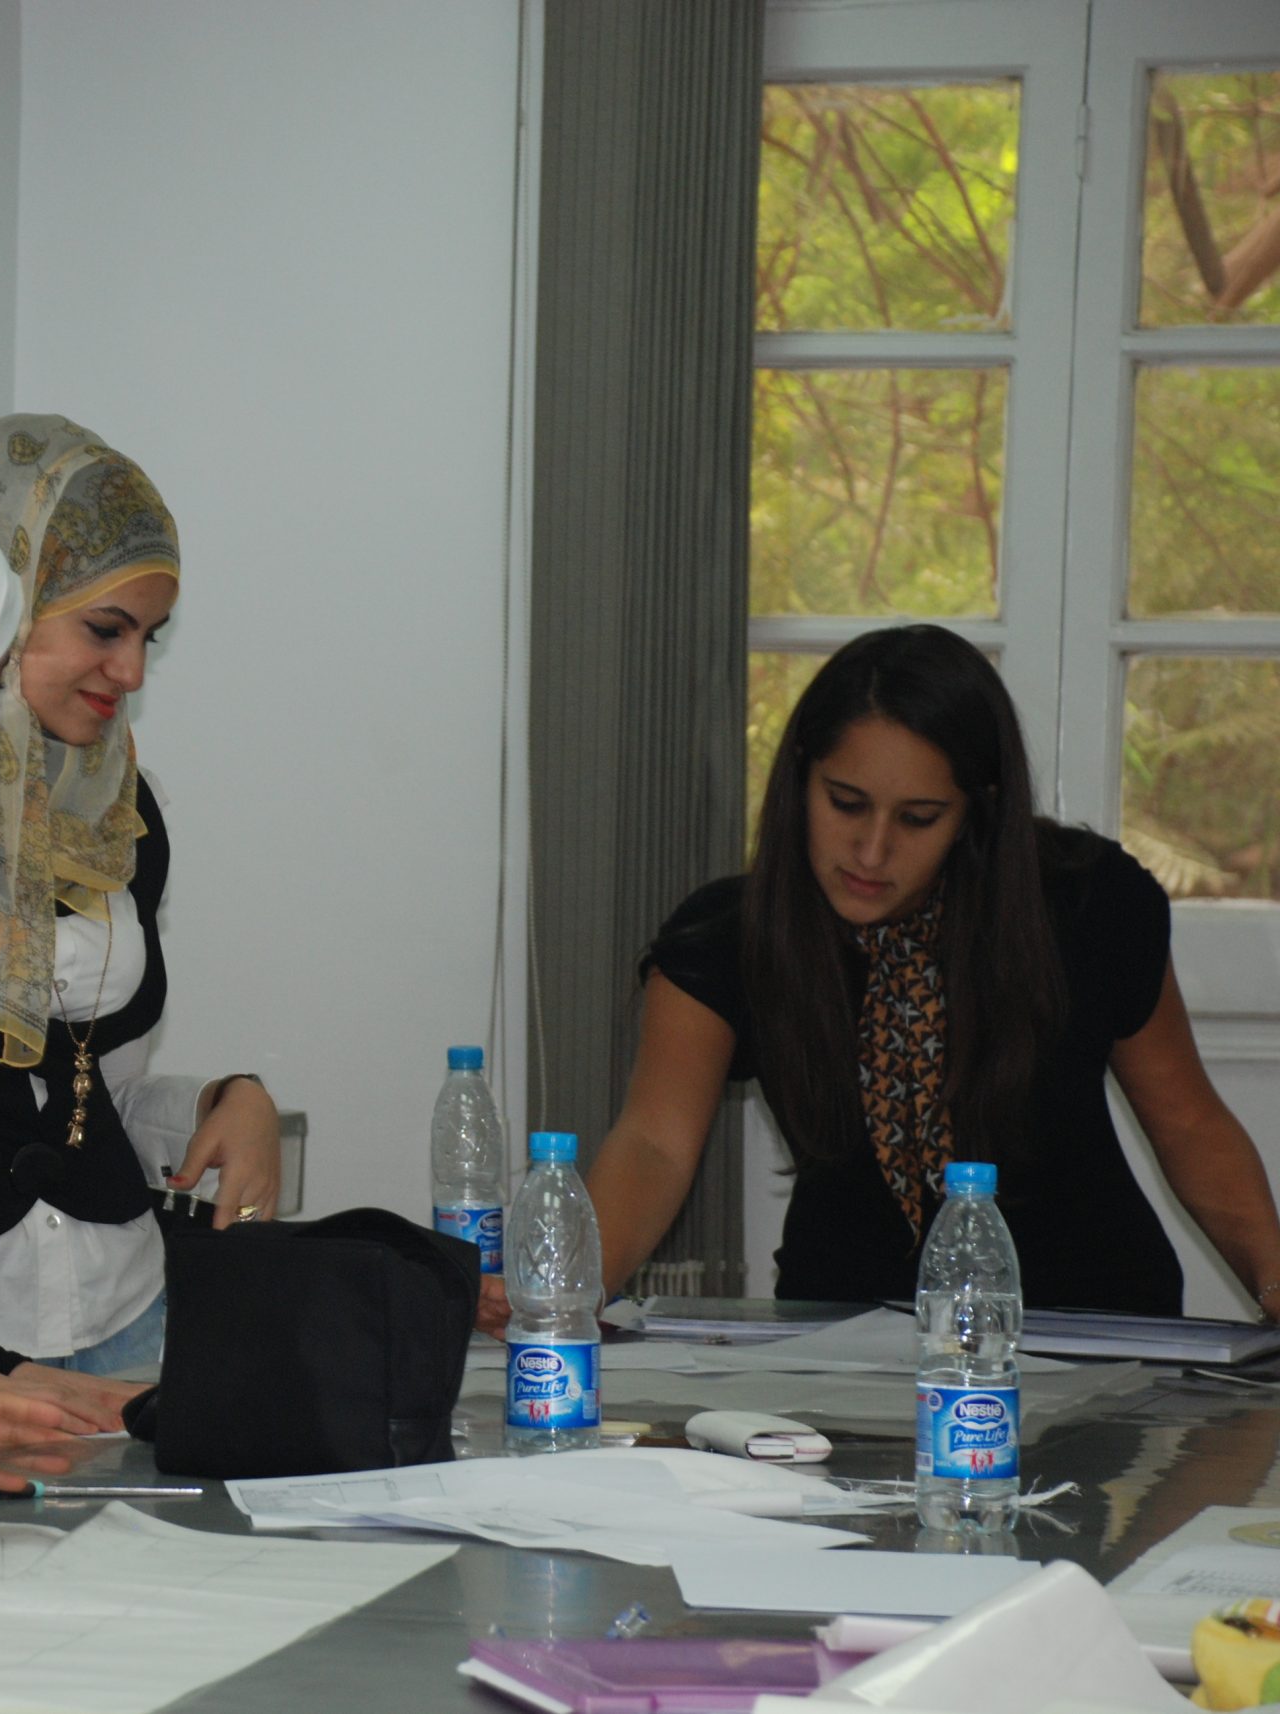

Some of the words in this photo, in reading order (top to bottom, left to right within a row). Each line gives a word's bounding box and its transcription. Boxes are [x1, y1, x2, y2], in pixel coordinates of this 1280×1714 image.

[517, 1381, 539, 1393] Pure
[540, 1380, 565, 1393] Life
[953, 1429, 983, 1443] Pure
[985, 1428, 1006, 1442] Life
